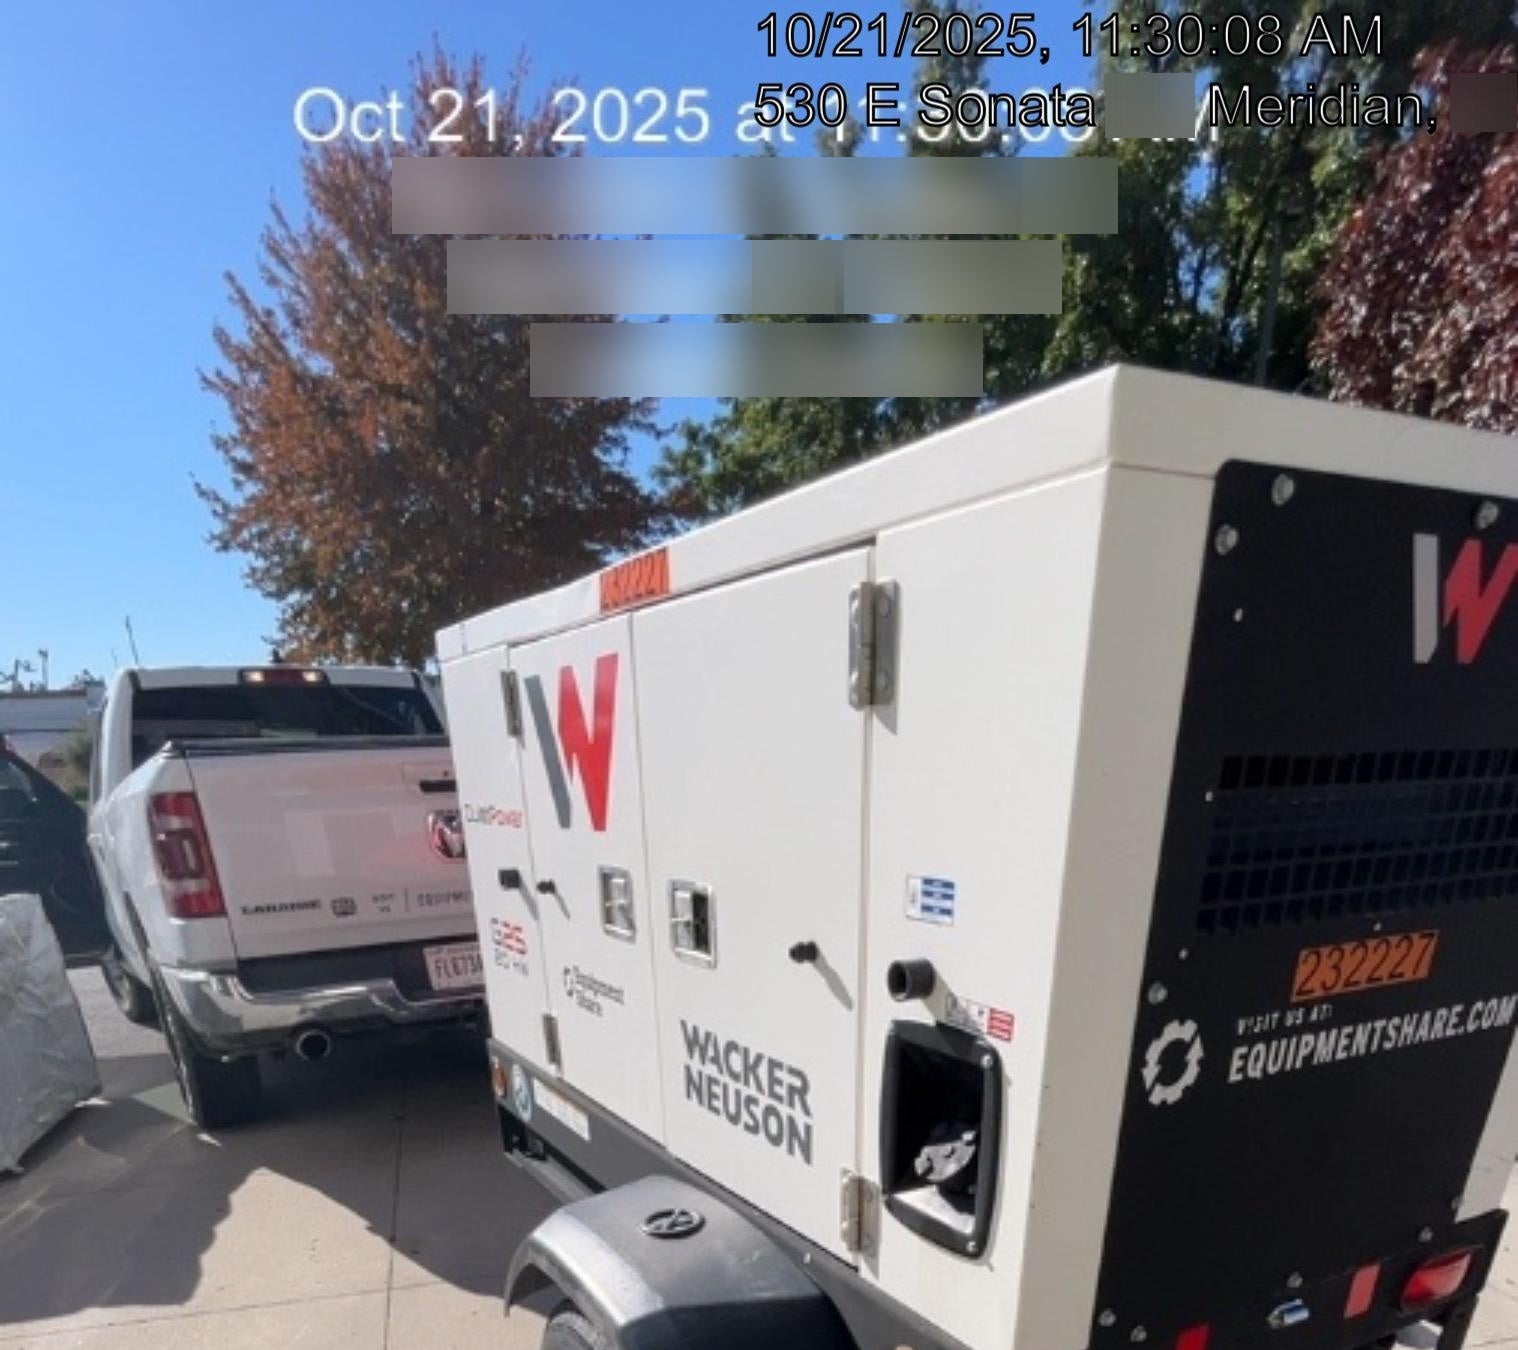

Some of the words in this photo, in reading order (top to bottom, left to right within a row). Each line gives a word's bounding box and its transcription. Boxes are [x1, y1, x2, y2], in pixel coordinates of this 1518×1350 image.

[1296, 934, 1434, 994] 232227
[680, 1019, 811, 1118] WACKER
[1227, 993, 1518, 1083] EQUIPMENTSHARE.COM
[684, 1064, 813, 1166] NEUSON
